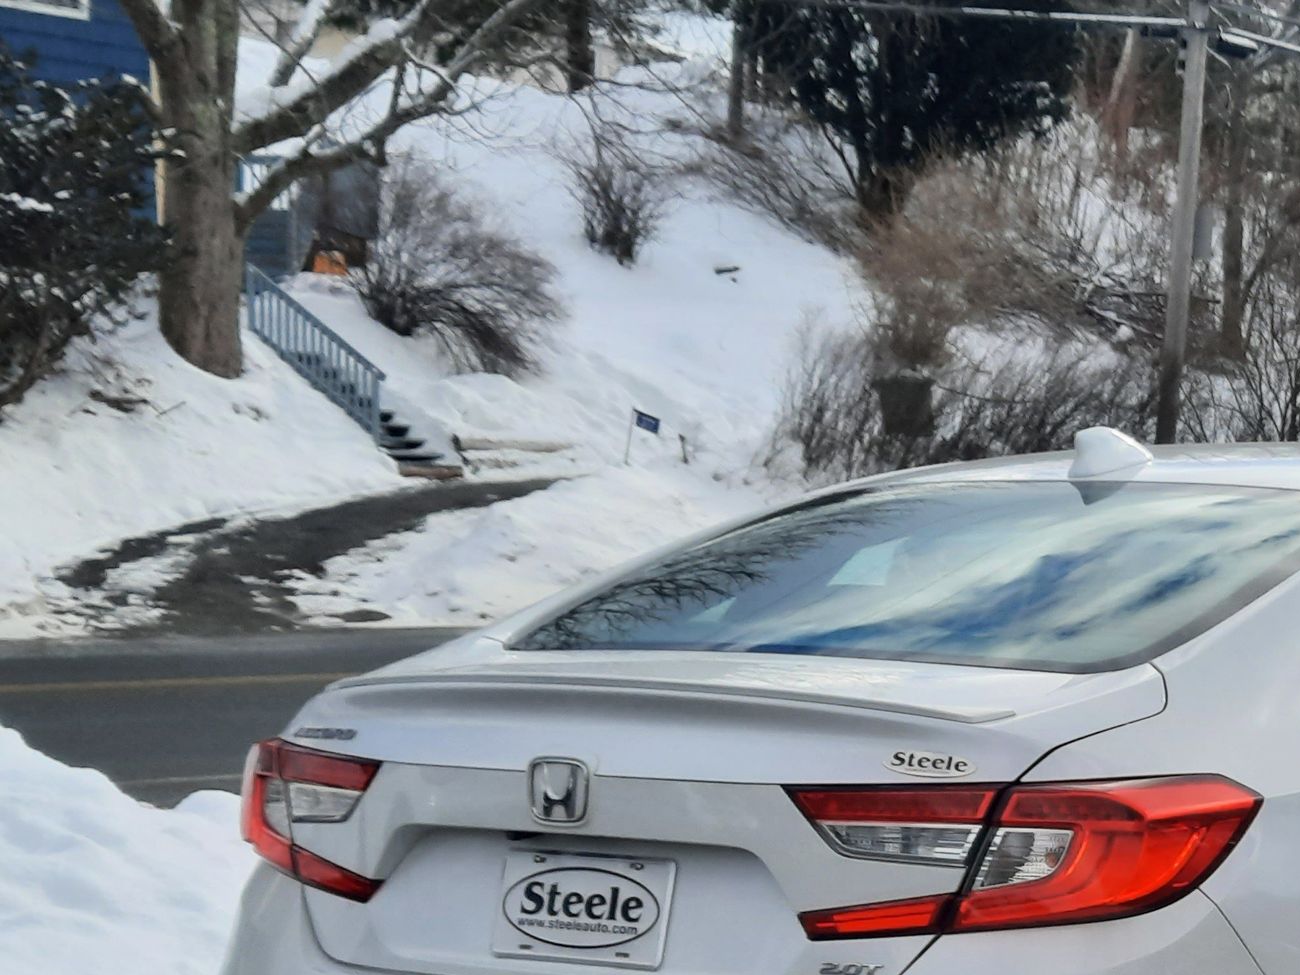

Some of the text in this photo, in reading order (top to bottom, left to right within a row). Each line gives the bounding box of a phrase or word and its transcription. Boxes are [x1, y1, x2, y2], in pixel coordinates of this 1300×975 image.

[891, 751, 968, 772] Steele
[520, 881, 644, 923] Steele
[517, 916, 638, 935] www.steeleauto.com
